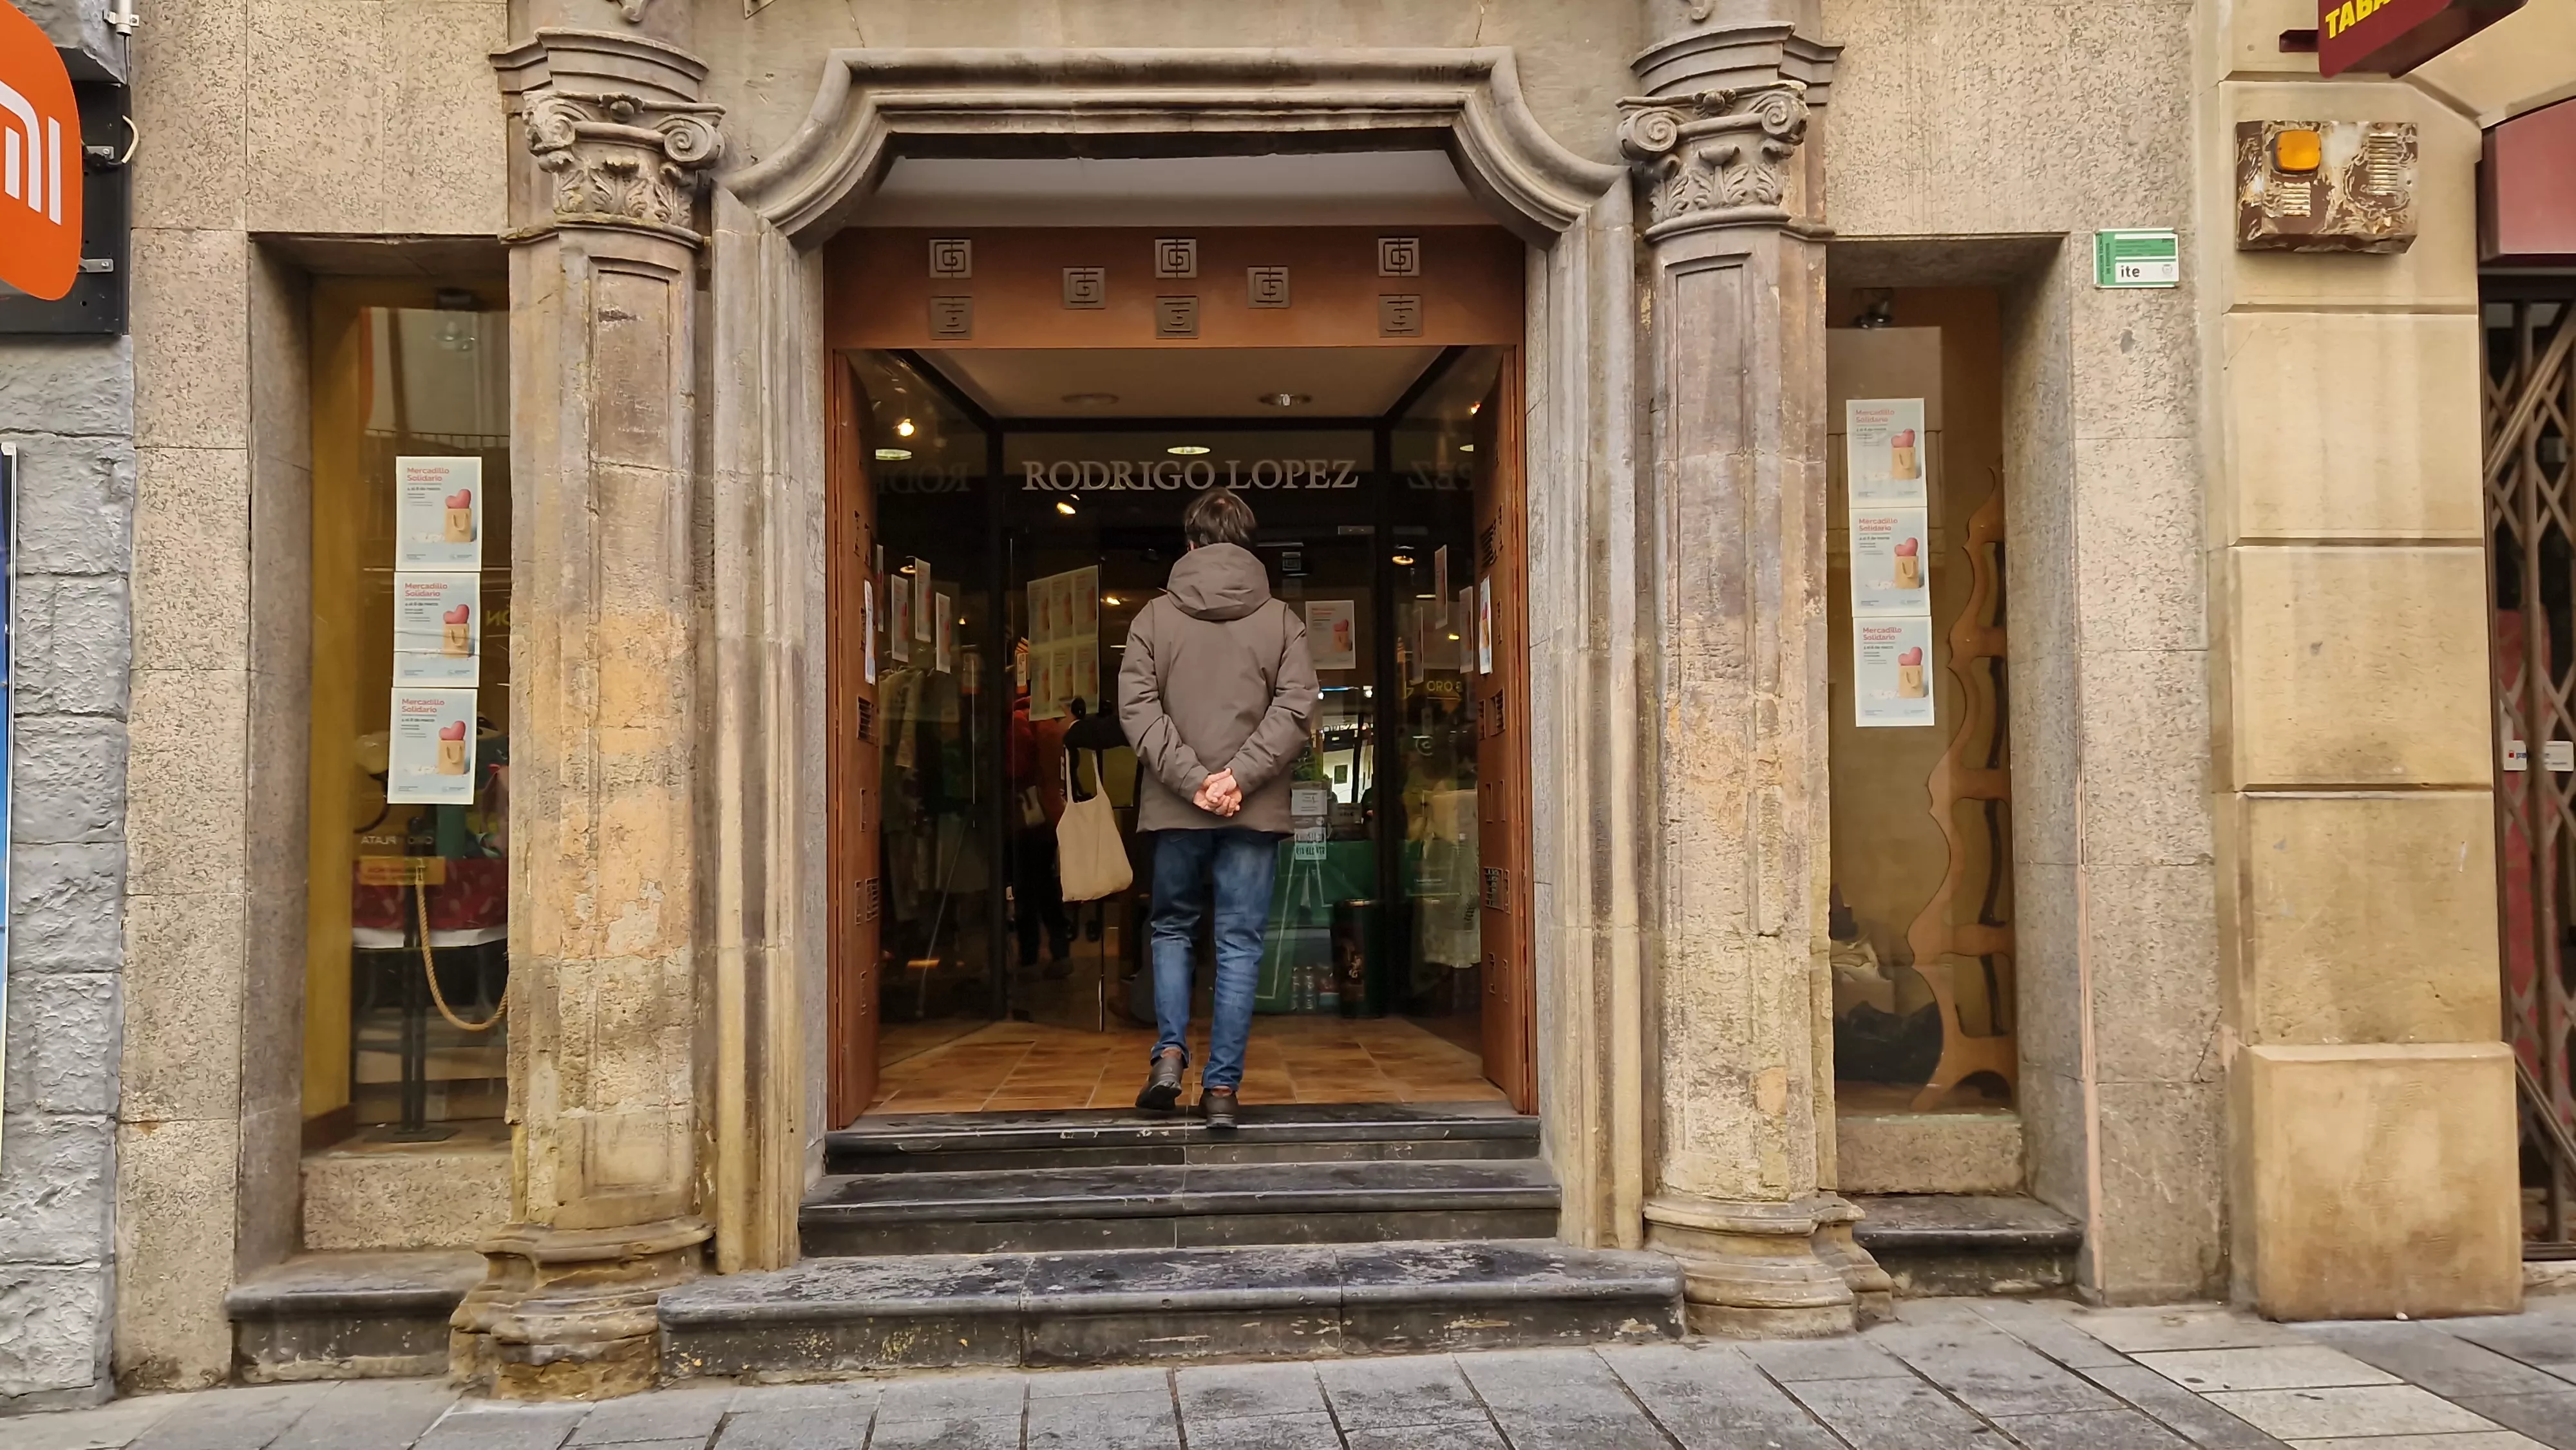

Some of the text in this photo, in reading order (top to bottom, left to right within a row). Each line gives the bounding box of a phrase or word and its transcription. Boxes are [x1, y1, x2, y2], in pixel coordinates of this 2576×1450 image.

[2121, 265, 2140, 278] ite
[1022, 460, 1358, 491] RODRIGO LOPEZ
